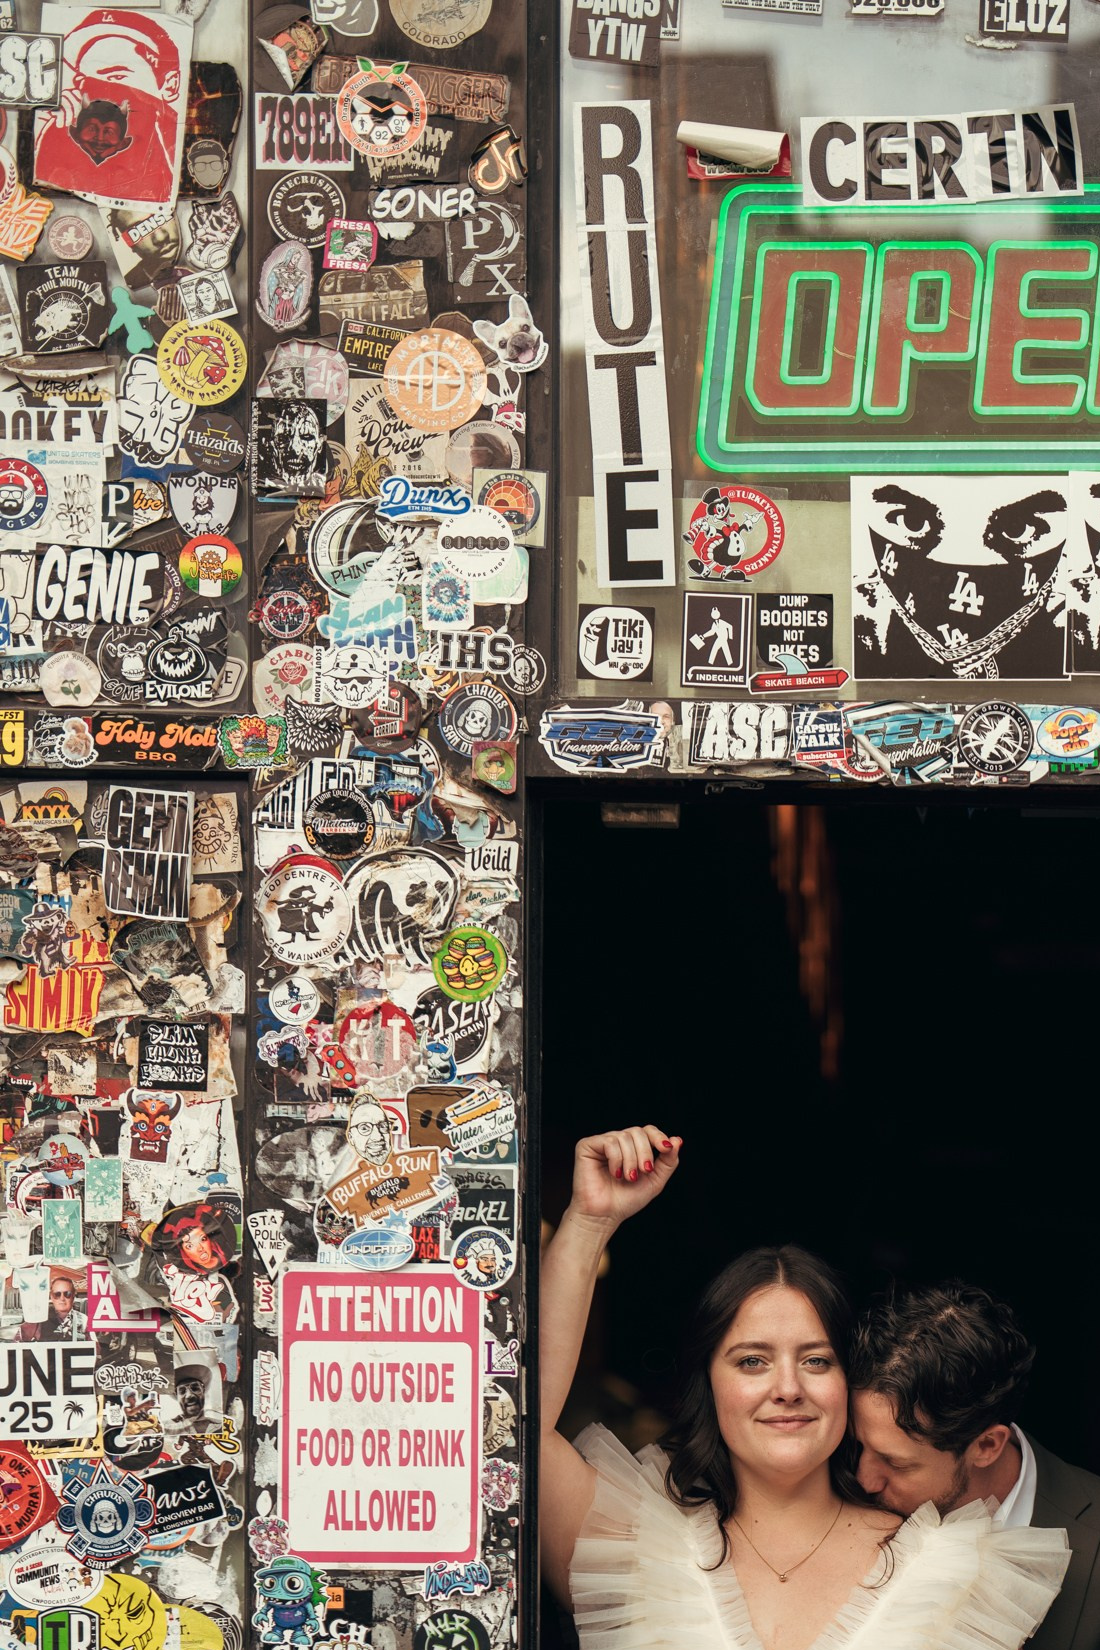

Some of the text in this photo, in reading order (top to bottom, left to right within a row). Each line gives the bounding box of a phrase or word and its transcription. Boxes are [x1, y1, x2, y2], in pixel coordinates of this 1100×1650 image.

[803, 3, 821, 12] UGLY
[402, 21, 467, 47] COLORADO
[586, 18, 645, 61] YTW
[808, 108, 1078, 202] CERTN
[273, 174, 341, 208] BONECRUSHER
[333, 220, 372, 231] FRESA
[45, 267, 80, 279] TEAM
[329, 259, 369, 270] FRESA
[37, 279, 91, 296] FOUL MOUTH
[345, 341, 392, 361] EMPIRE
[580, 104, 664, 582] RUTE
[187, 432, 244, 456] Hazards
[173, 475, 238, 490] WONDER
[442, 536, 509, 550] RIALTO
[37, 544, 160, 623] GENIE
[779, 595, 809, 608] DUMP
[760, 611, 828, 627] BOOBIES
[784, 629, 805, 642] NOT
[437, 633, 513, 673] IHS
[768, 645, 820, 663] BIKES
[696, 673, 745, 684] INDECLINE
[765, 675, 825, 687] SKATE BEACH
[701, 704, 788, 761] ASC
[980, 704, 1029, 745] GROWER CIRCLE
[95, 720, 217, 751] Holy Moli
[800, 734, 842, 748] TALK
[134, 750, 177, 762] BBQ
[558, 740, 642, 754] Transportation
[802, 751, 838, 760] subscribe
[985, 763, 1003, 772] 2013
[21, 804, 71, 820] KYYX
[284, 869, 327, 885] CENTRE
[287, 929, 346, 961] WAINWRIGHT
[334, 1152, 435, 1205] BUFFALO RUN
[395, 1189, 433, 1208] CHALLENGE
[297, 1286, 464, 1332] ATTENTION
[309, 1362, 455, 1403] NO OUTSIDE
[298, 1428, 465, 1467] FOOD OR DRINK
[154, 1502, 214, 1526] LONGVIEW BAR
[324, 1490, 437, 1532] ALLOWED
[16, 1564, 60, 1584] COMMUNITY
[39, 1574, 61, 1588] NEWS
